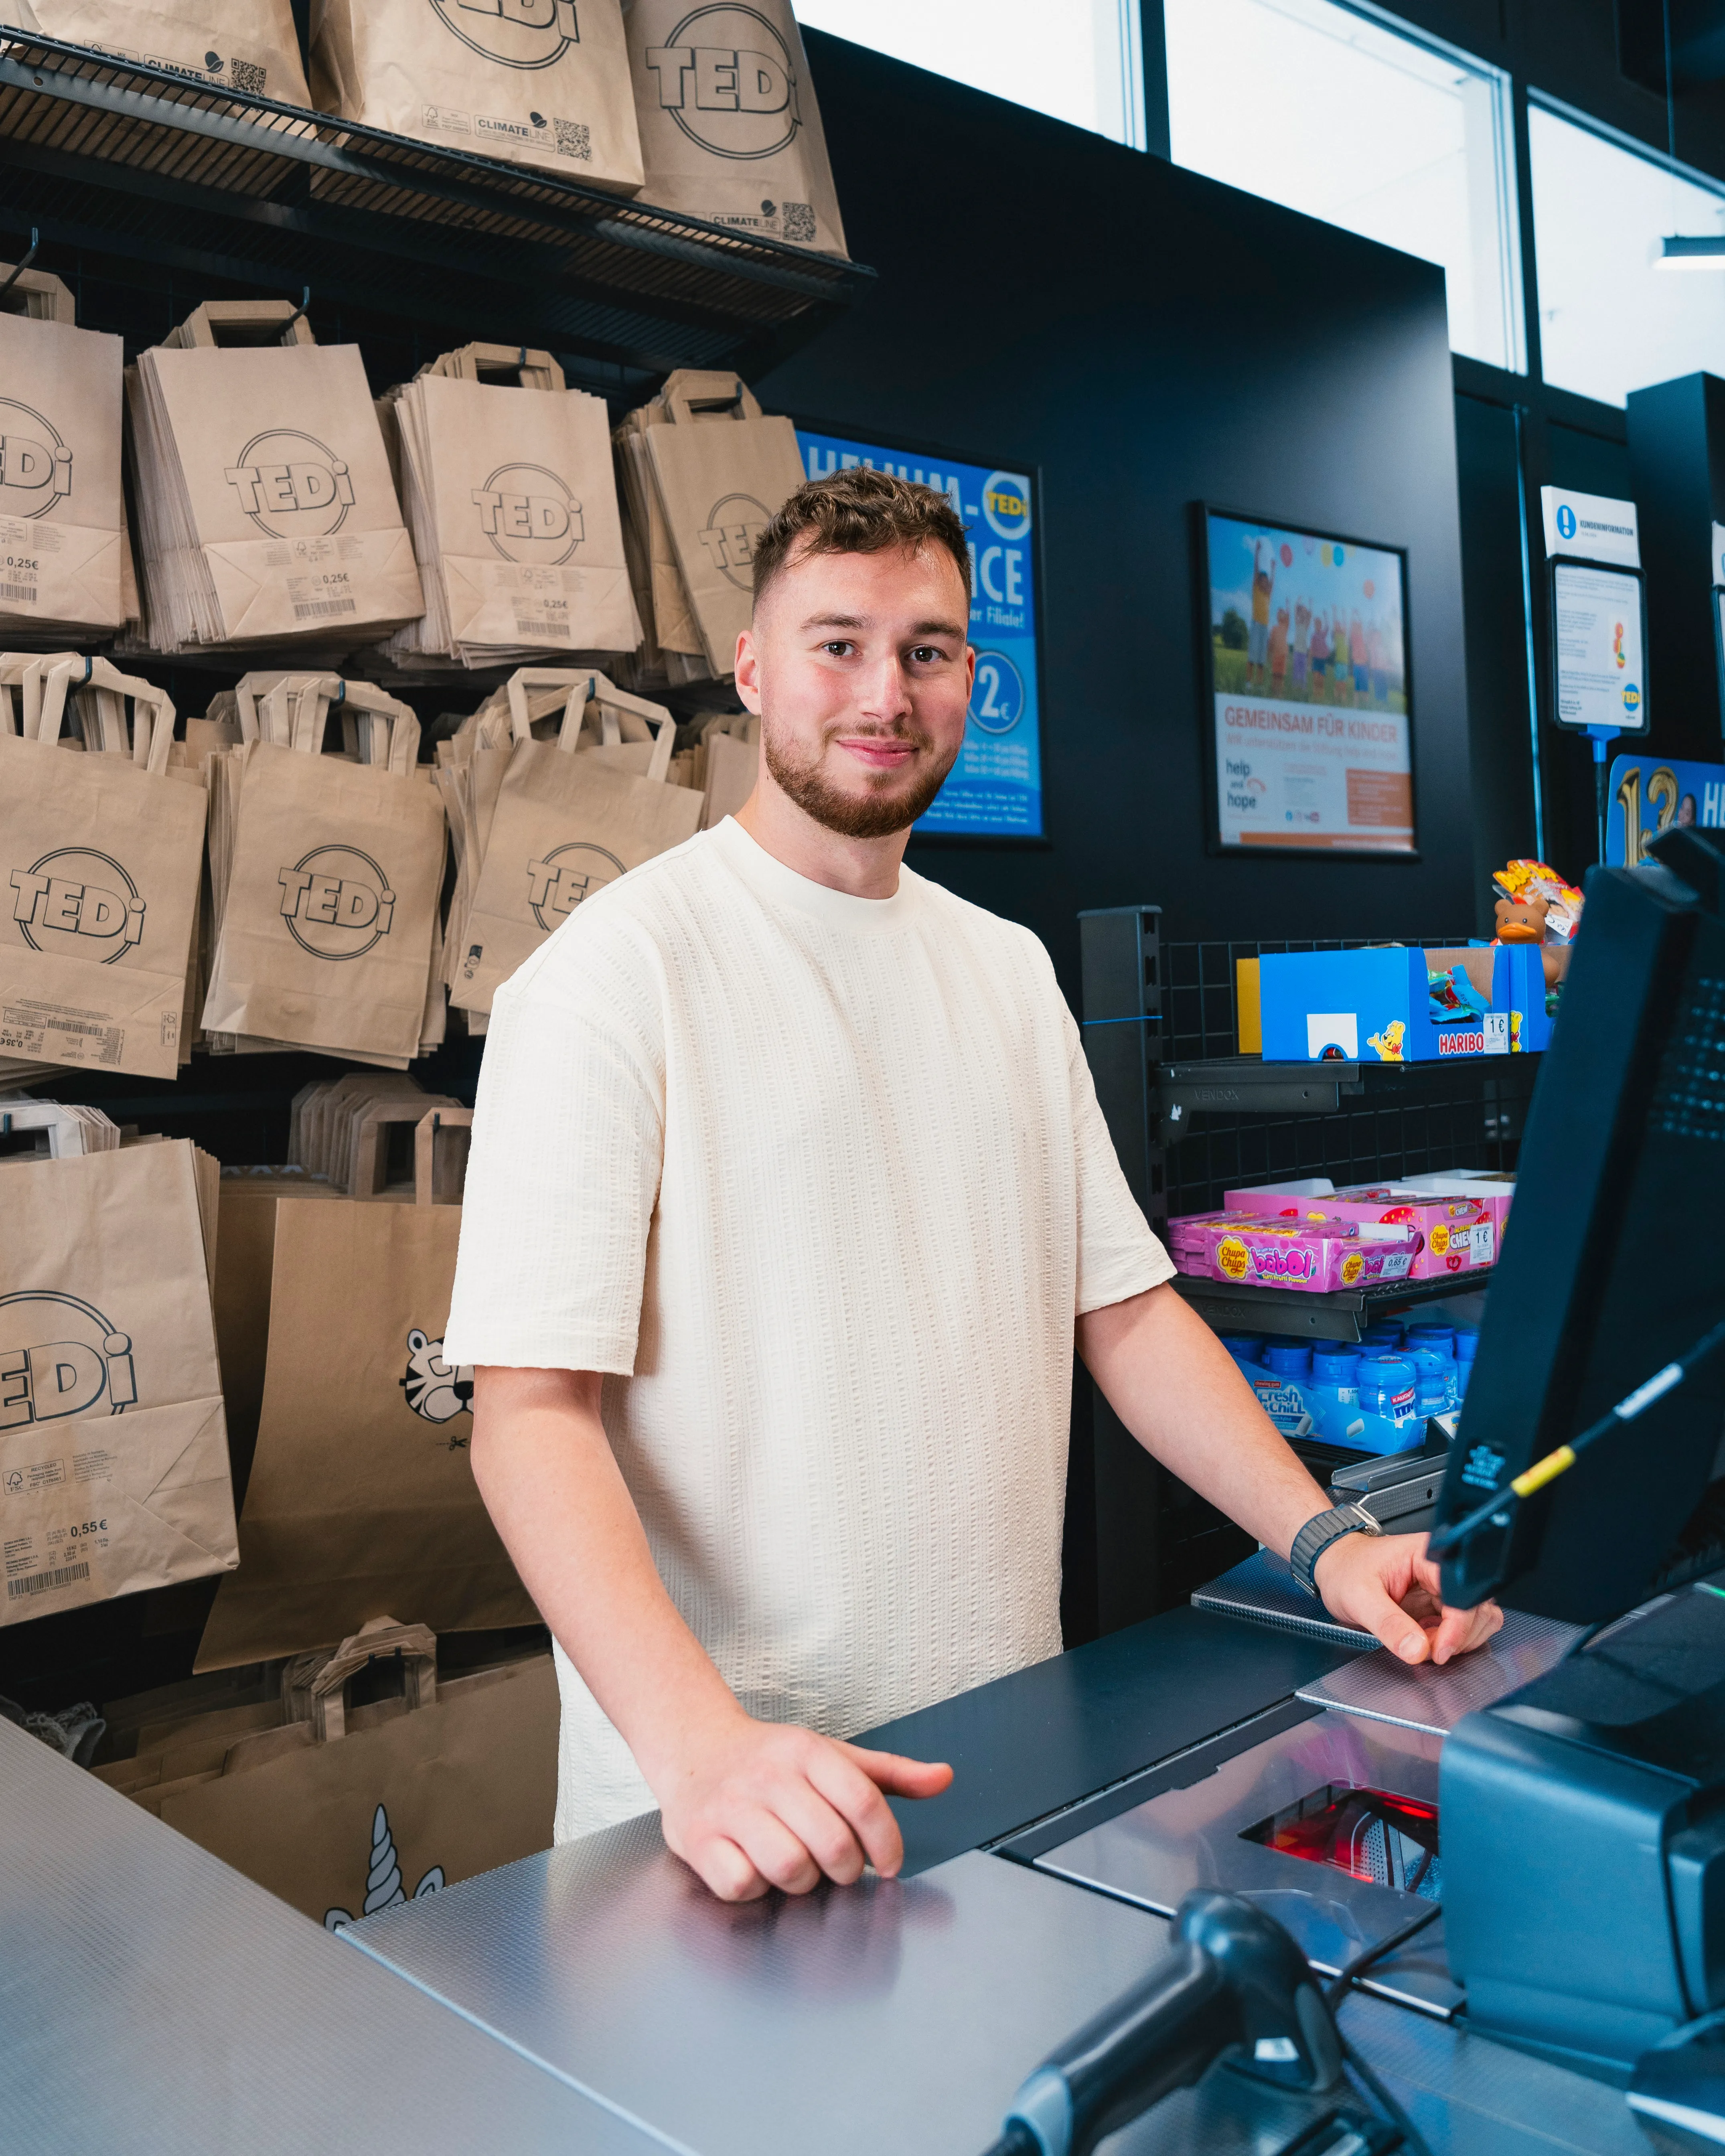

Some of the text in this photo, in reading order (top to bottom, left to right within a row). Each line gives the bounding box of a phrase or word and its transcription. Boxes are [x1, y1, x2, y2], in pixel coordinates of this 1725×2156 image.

[478, 119, 551, 142] CLIMATELINE
[224, 460, 355, 513] TEDi
[470, 489, 585, 541] TEDi
[1579, 520, 1634, 537] KUNDENINFORMATION
[7, 556, 39, 570] 0,25€
[323, 573, 350, 585] 0,25€
[1224, 706, 1397, 743] GEMEINSAM FÜR KINDER
[1226, 758, 1251, 778] help
[1227, 792, 1257, 812] hope
[10, 869, 146, 945] TEDi
[278, 867, 396, 934] TEDi
[1440, 1034, 1484, 1054] HARIBO
[1222, 1246, 1246, 1258] Chupa
[1432, 1240, 1447, 1250] Chups
[1221, 1256, 1246, 1270] Chups
[1343, 1268, 1359, 1278] Chups
[1346, 1261, 1361, 1269] Chupa
[0, 1332, 138, 1430] EDi
[31, 1463, 57, 1472] RECYCLED
